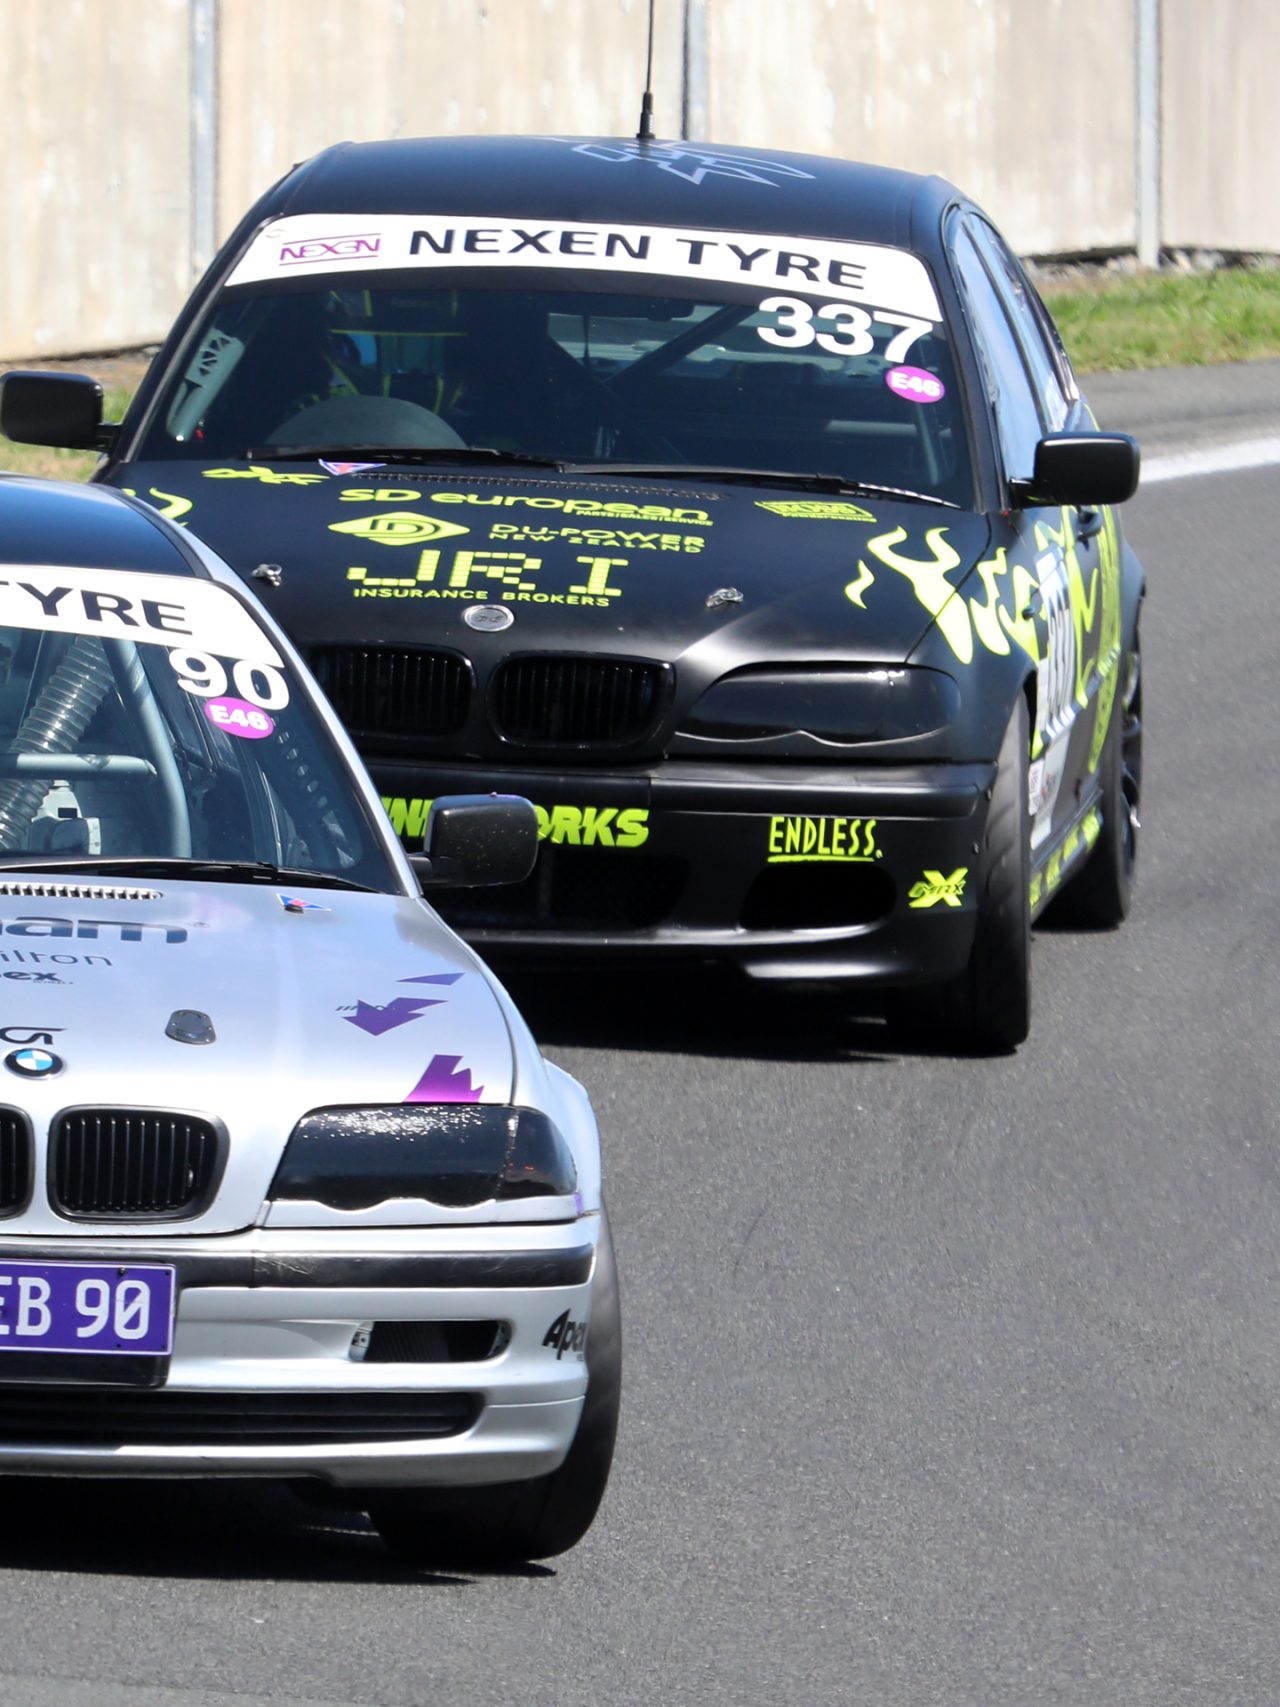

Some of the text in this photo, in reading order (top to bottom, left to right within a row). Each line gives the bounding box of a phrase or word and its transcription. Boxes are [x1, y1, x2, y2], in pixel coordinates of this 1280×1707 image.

[408, 228, 868, 290] NEXEN TYRE
[757, 295, 934, 364] 337
[889, 371, 942, 396] E46
[338, 488, 709, 521] SD european
[488, 532, 702, 554] NEW ZEALAND
[491, 523, 705, 548] DU-POWER
[347, 550, 629, 596] JRI
[353, 588, 611, 607] INSURANCE BROKERS
[168, 647, 290, 711] 90
[208, 703, 269, 732] E46
[75, 1278, 151, 1340] 90
